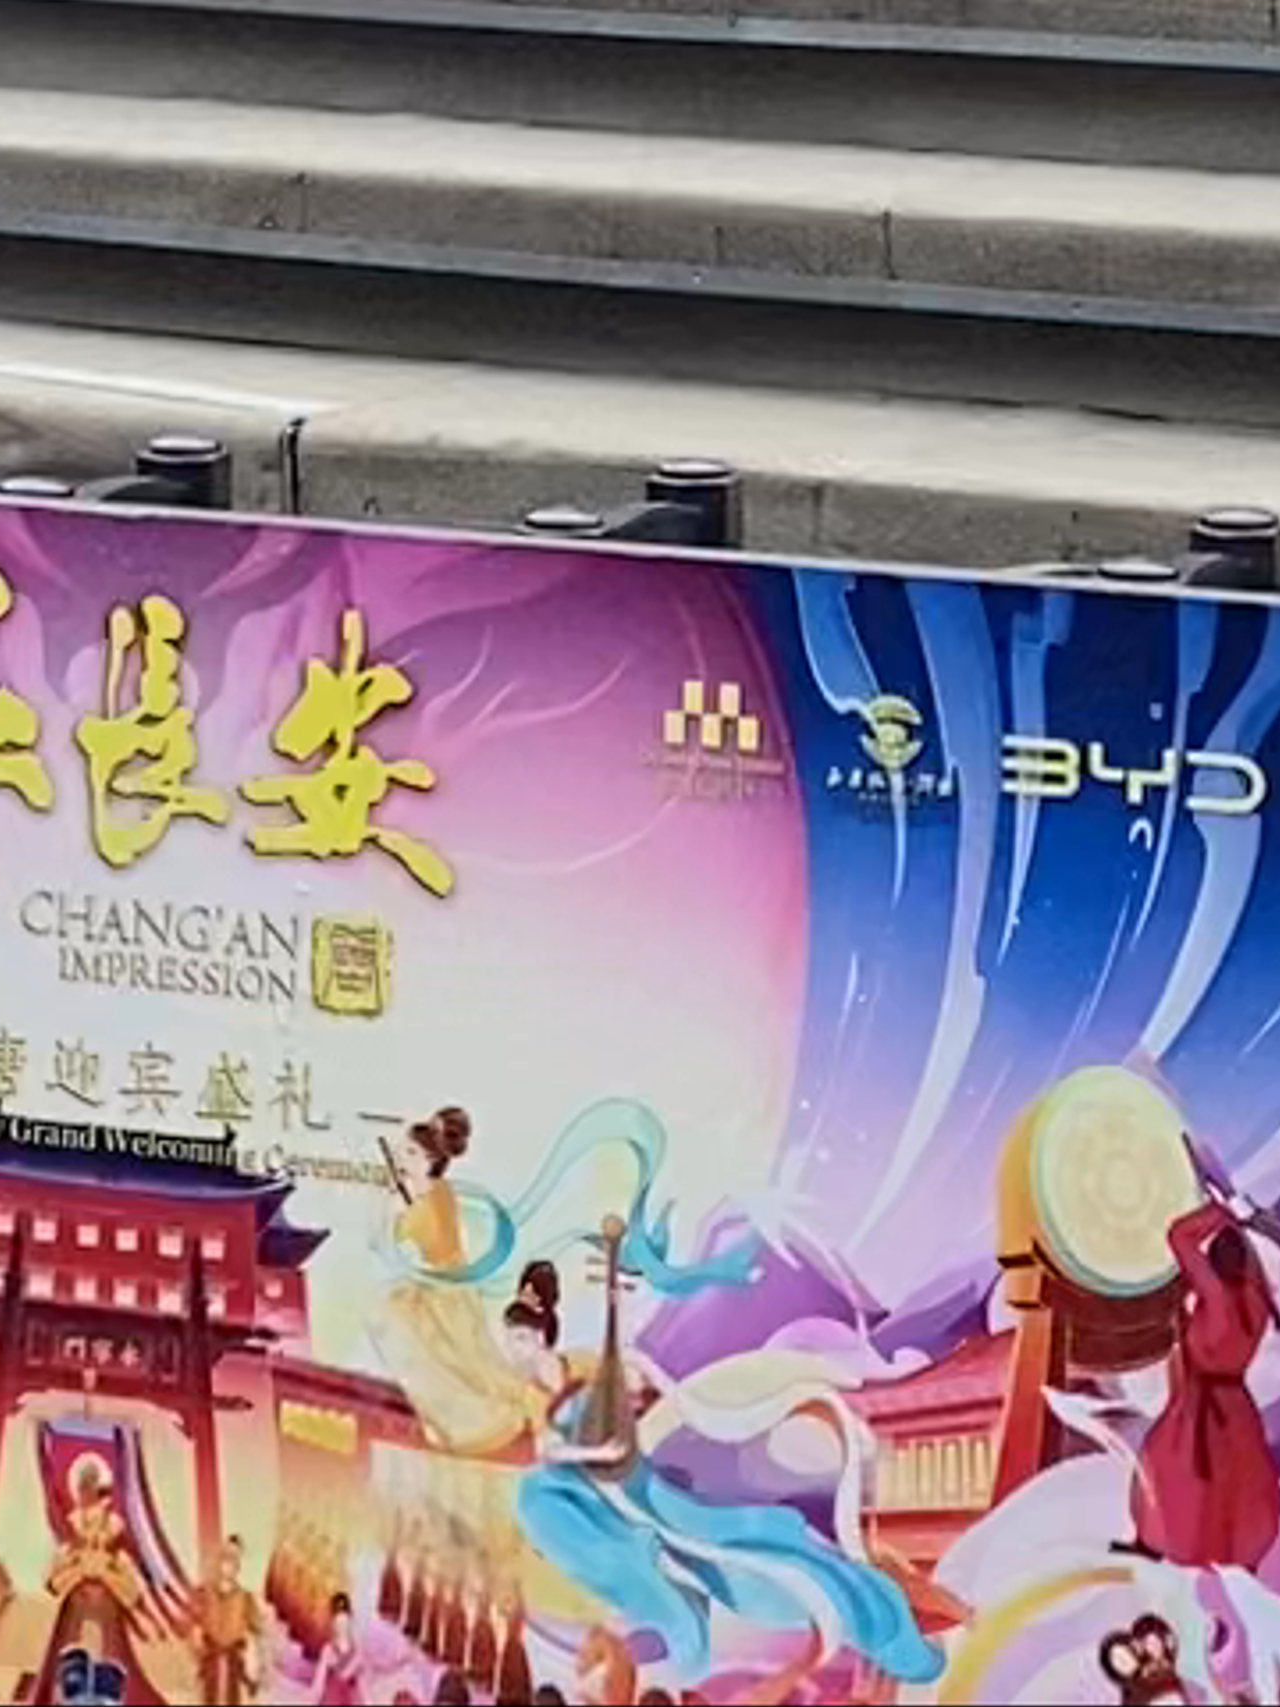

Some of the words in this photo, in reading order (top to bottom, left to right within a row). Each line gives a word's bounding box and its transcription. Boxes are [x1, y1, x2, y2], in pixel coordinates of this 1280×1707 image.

[1001, 734, 1267, 812] BYD
[21, 889, 300, 961] CHANG'AN
[58, 946, 298, 1004] IMPRESSION
[10, 1116, 97, 1151] Grand
